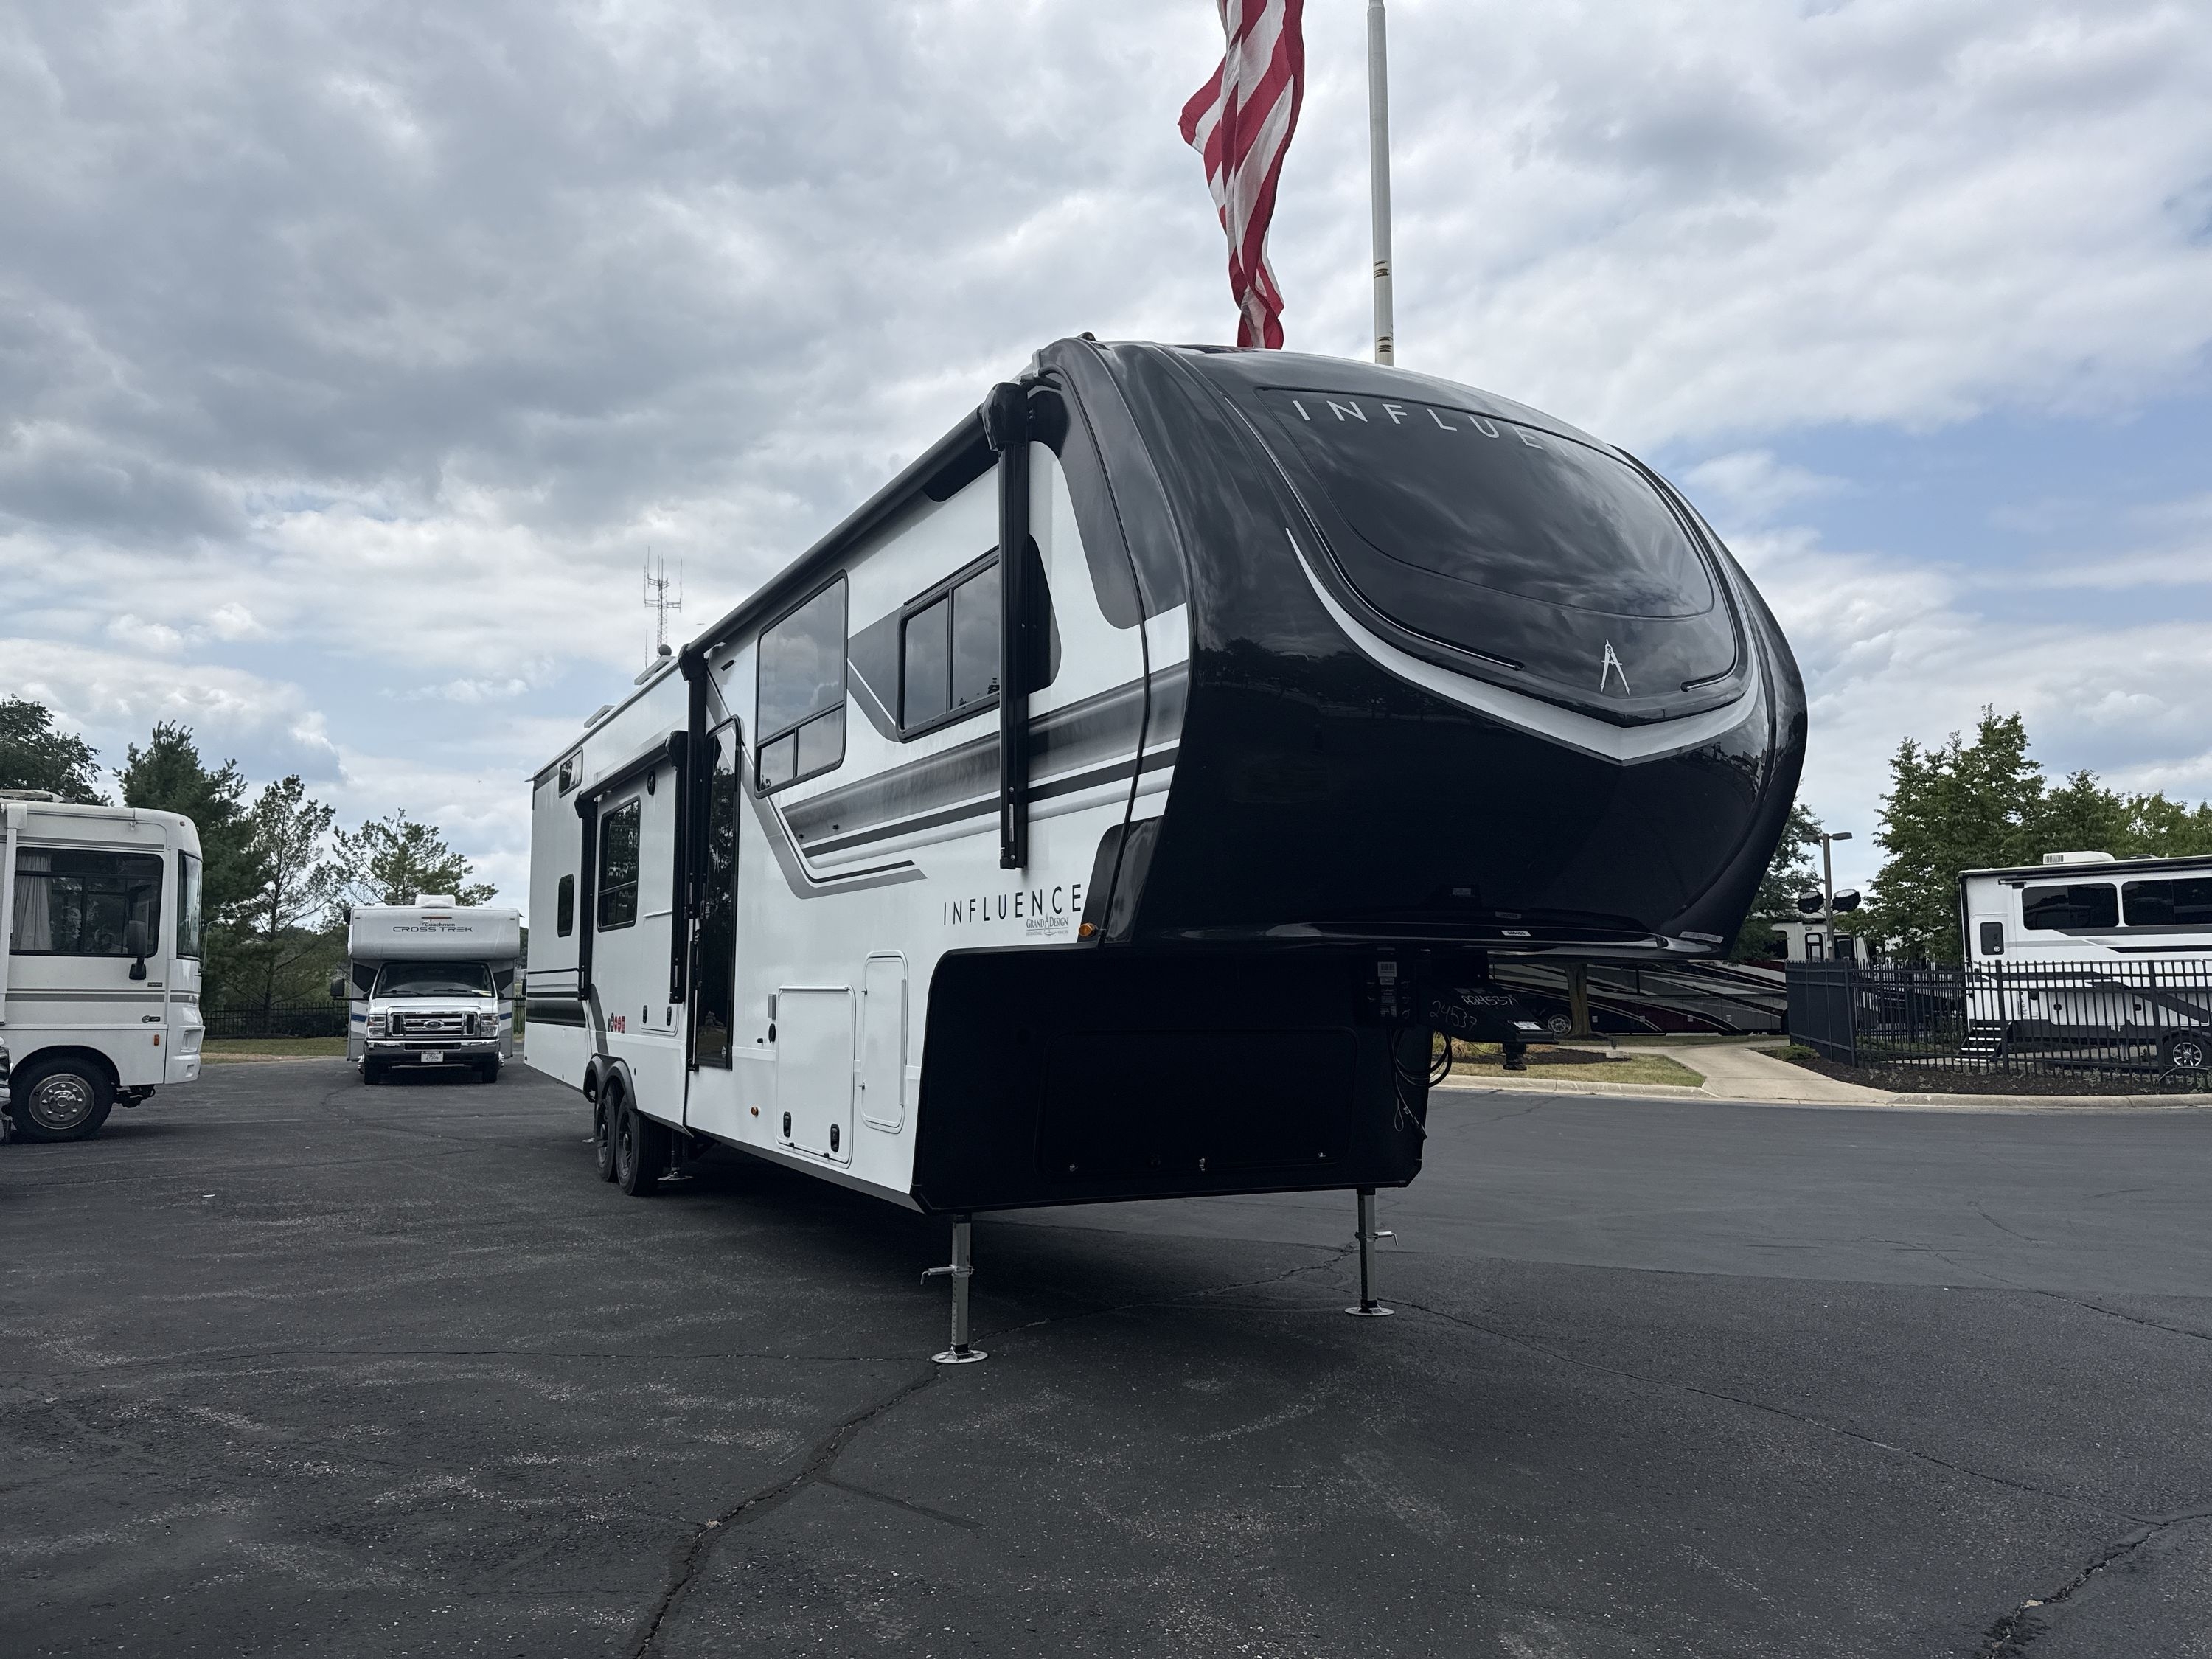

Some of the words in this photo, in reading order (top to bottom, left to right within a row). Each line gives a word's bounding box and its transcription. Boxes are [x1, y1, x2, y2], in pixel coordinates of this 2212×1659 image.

[1292, 400, 1569, 457] INFLUE
[944, 884, 1082, 926] INFLUENCE
[1026, 918, 1045, 929] GRAND
[1049, 917, 1068, 928] DESIGN
